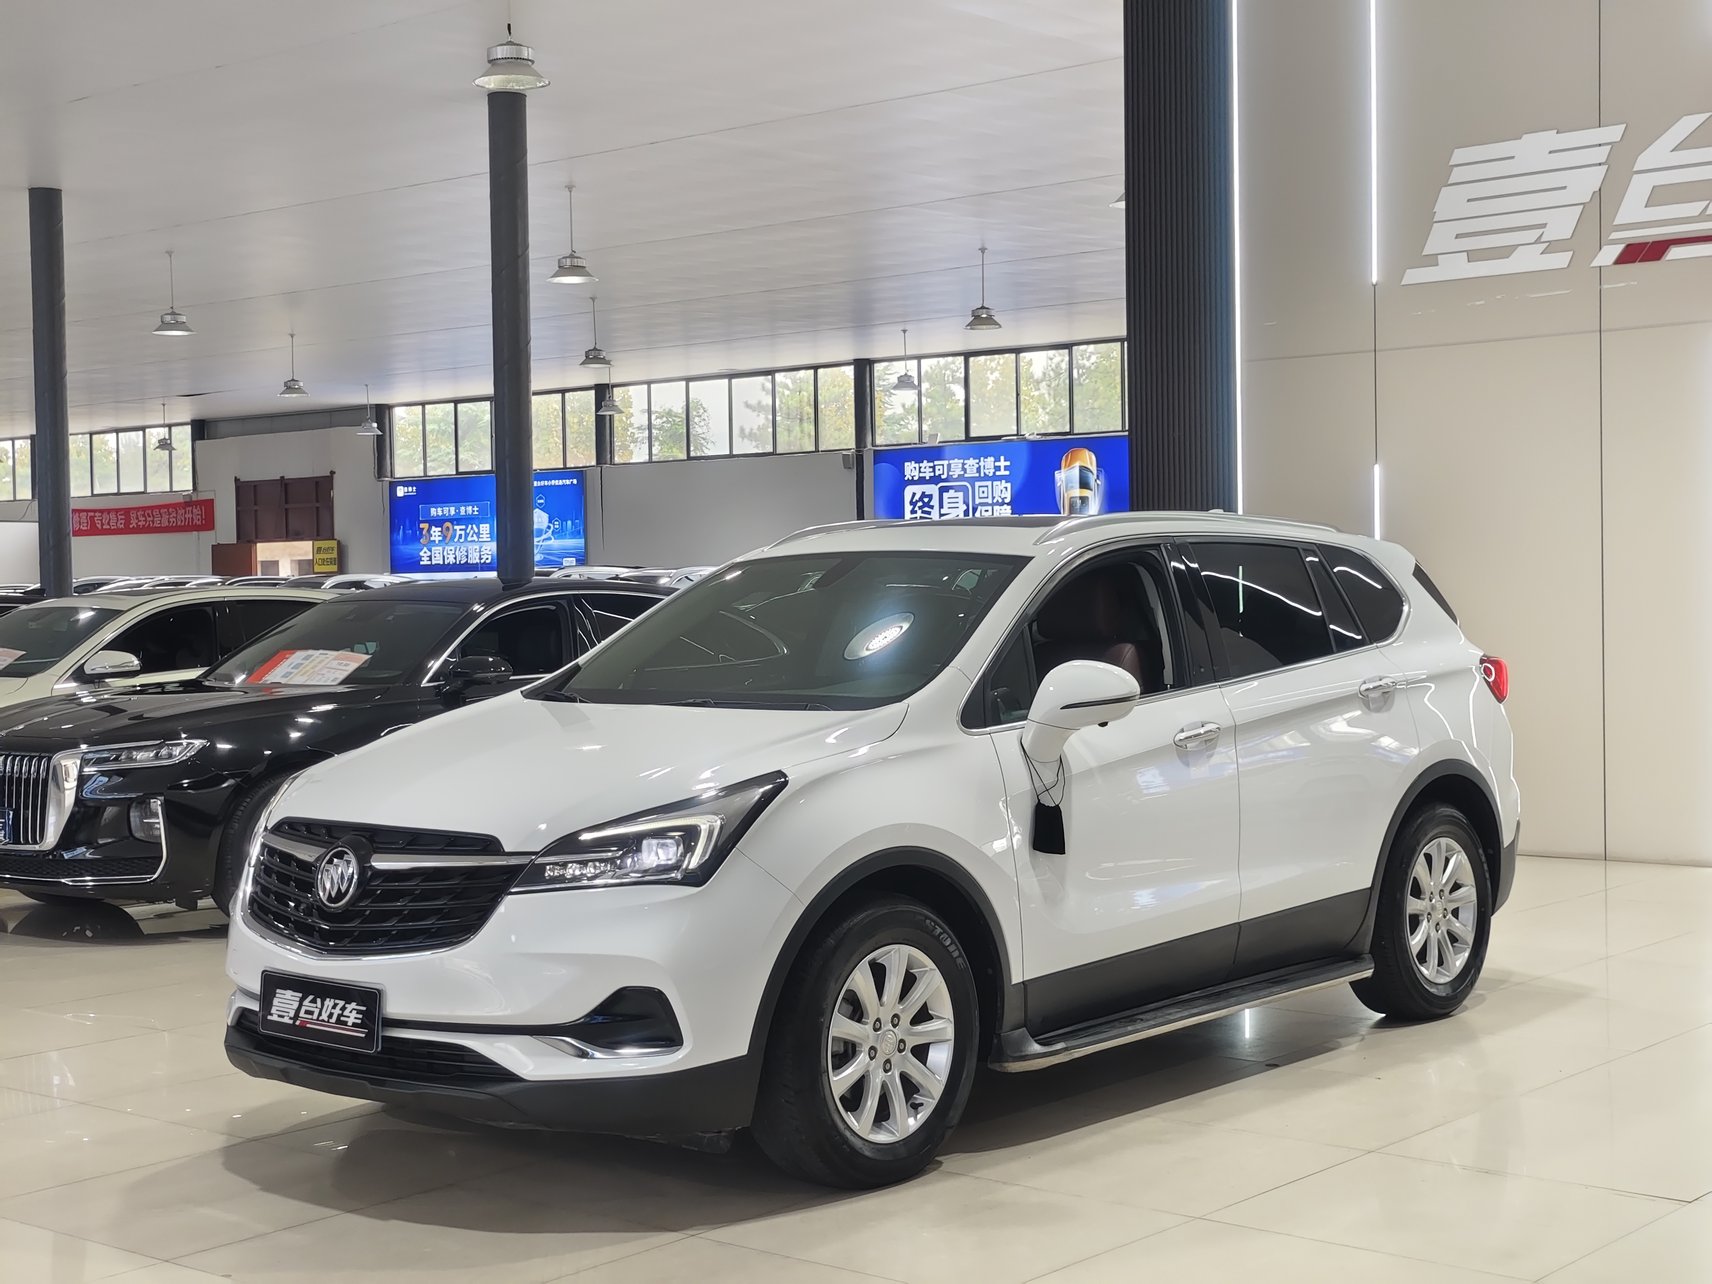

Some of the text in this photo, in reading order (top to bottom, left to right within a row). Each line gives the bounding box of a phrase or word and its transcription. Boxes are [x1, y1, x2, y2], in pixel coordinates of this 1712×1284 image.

[904, 456, 1011, 480] 购车可享查博士
[909, 489, 968, 519] 终身
[974, 480, 1012, 504] 回购
[419, 521, 491, 545] 3年9万公里
[419, 545, 492, 566] 全国保修服务
[267, 988, 367, 1027] 壹台好车
